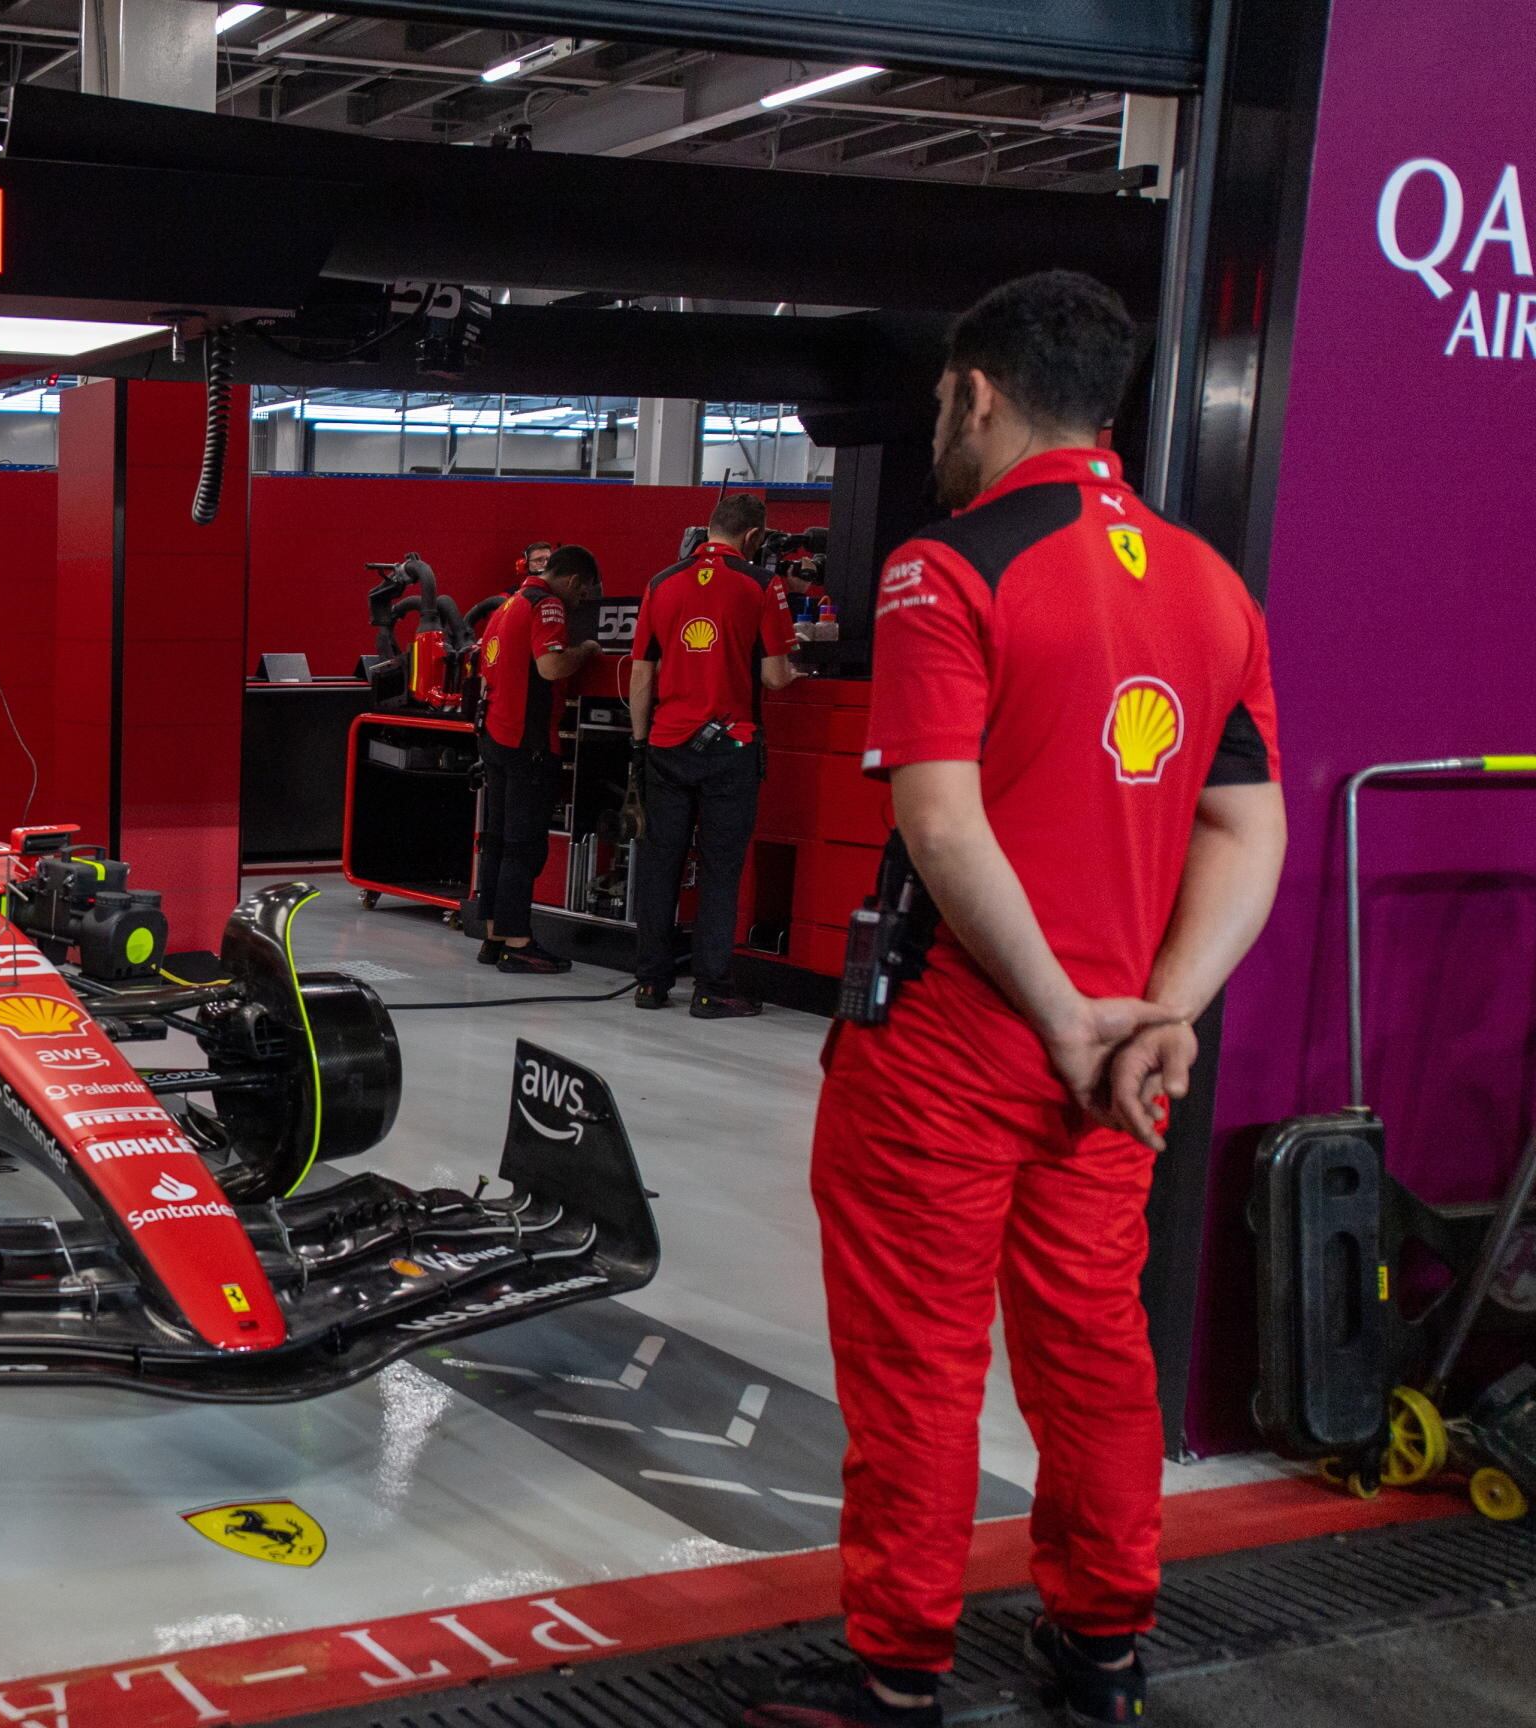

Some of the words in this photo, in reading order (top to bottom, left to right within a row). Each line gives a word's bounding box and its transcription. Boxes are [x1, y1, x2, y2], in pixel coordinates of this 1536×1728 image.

[597, 605, 639, 640] 55
[35, 1046, 102, 1063] aws
[71, 1080, 146, 1097] Palantir
[521, 1058, 584, 1116] aws
[2, 1083, 68, 1174] Santander
[63, 1107, 171, 1130] PIRELLI
[86, 1135, 198, 1164] MAHLE
[127, 1200, 238, 1231] Santander
[414, 1245, 515, 1272] V-Power
